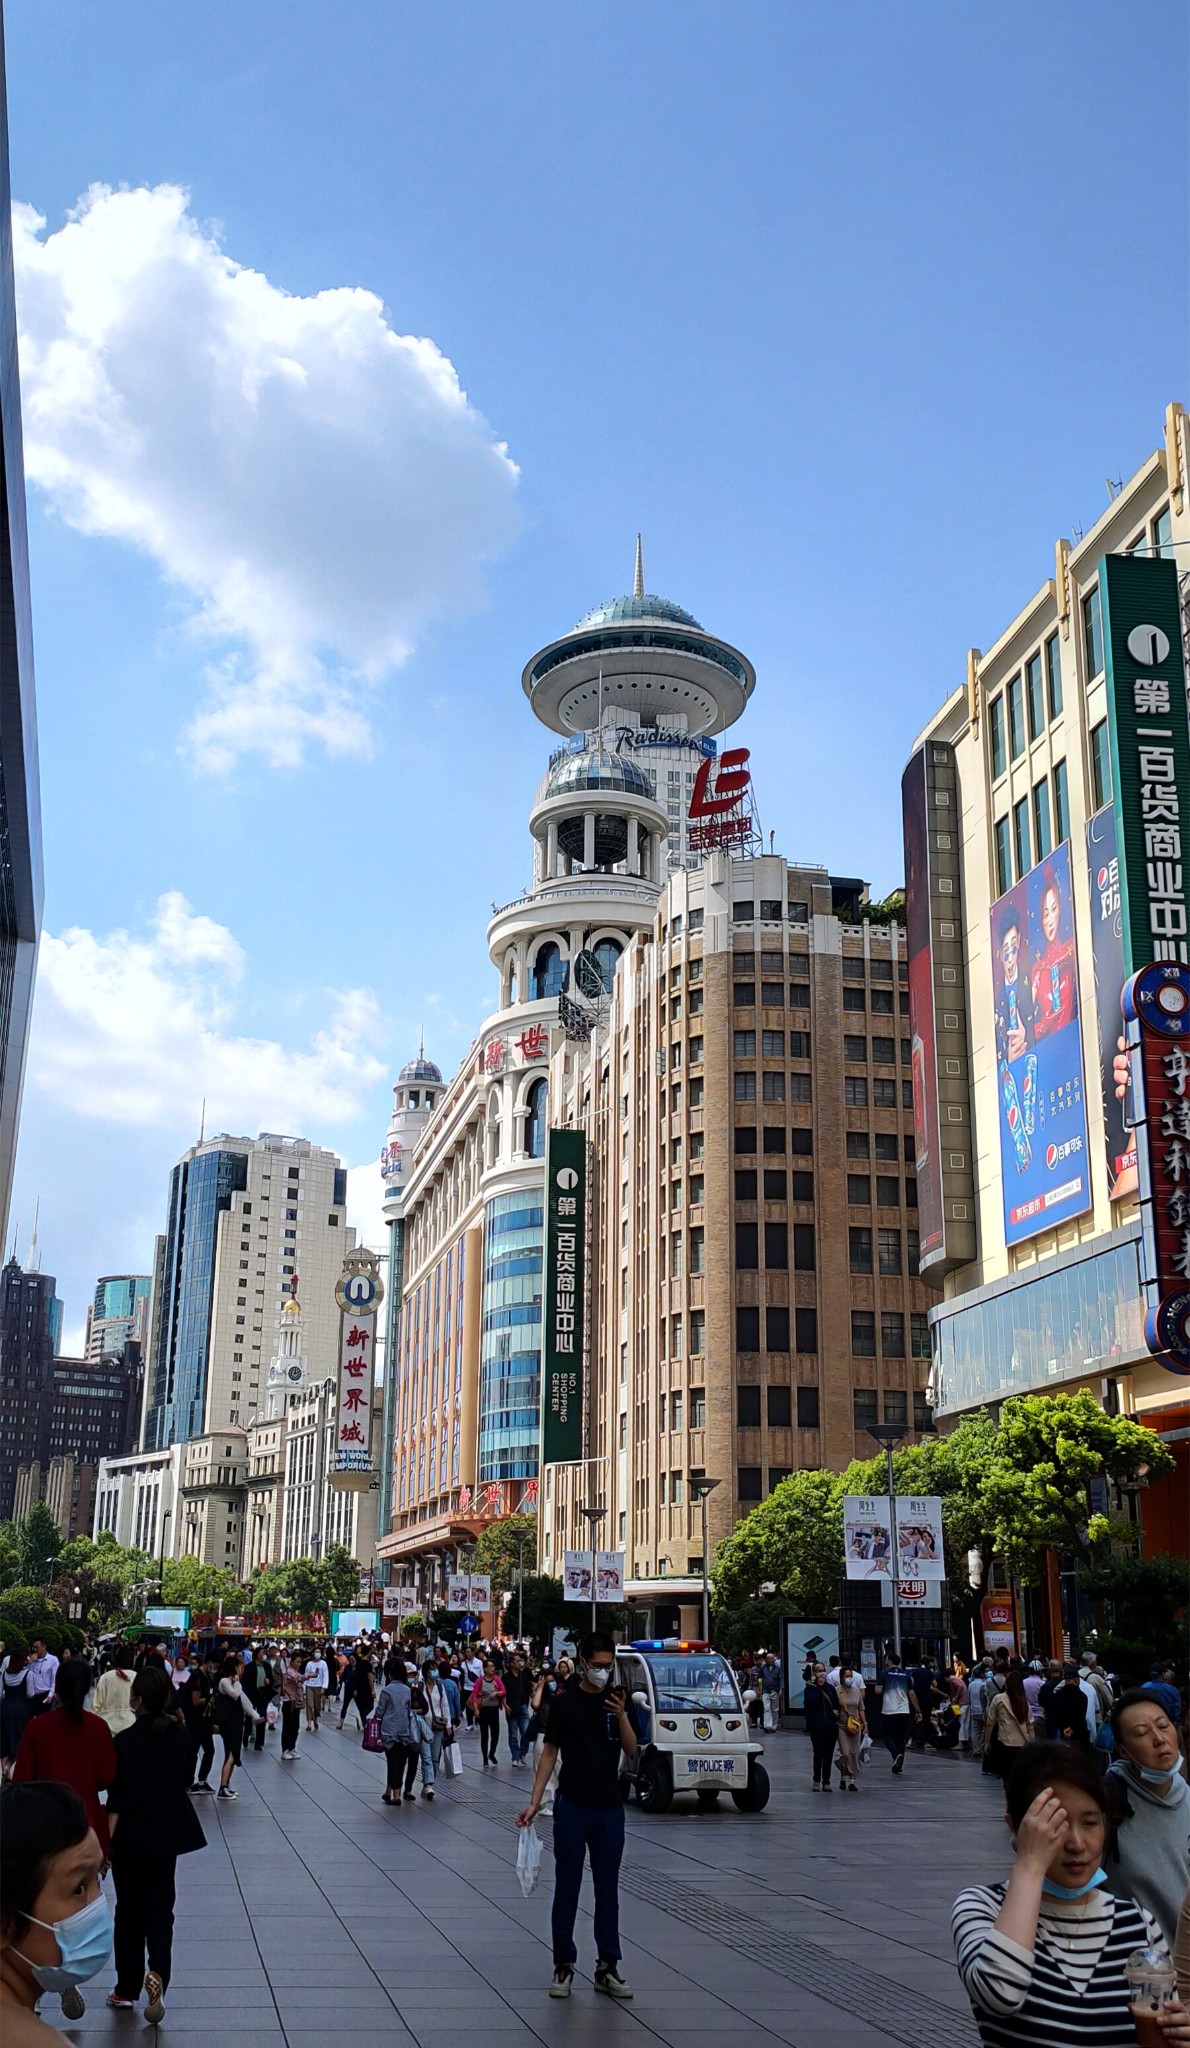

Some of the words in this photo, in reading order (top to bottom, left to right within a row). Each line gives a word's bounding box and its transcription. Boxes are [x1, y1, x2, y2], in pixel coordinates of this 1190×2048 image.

[616, 723, 700, 753] Radisson
[1058, 1135, 1083, 1161] 百事可乐
[1016, 1198, 1041, 1222] 京东超市
[555, 1196, 577, 1353] 第一百货商业中心
[340, 1324, 370, 1445] 新世界城
[551, 1372, 560, 1412] CENTER
[560, 1372, 569, 1423] SHOPPING
[568, 1372, 577, 1395] NO.1
[898, 1581, 925, 1593] 光明
[699, 1759, 723, 1772] POLICE
